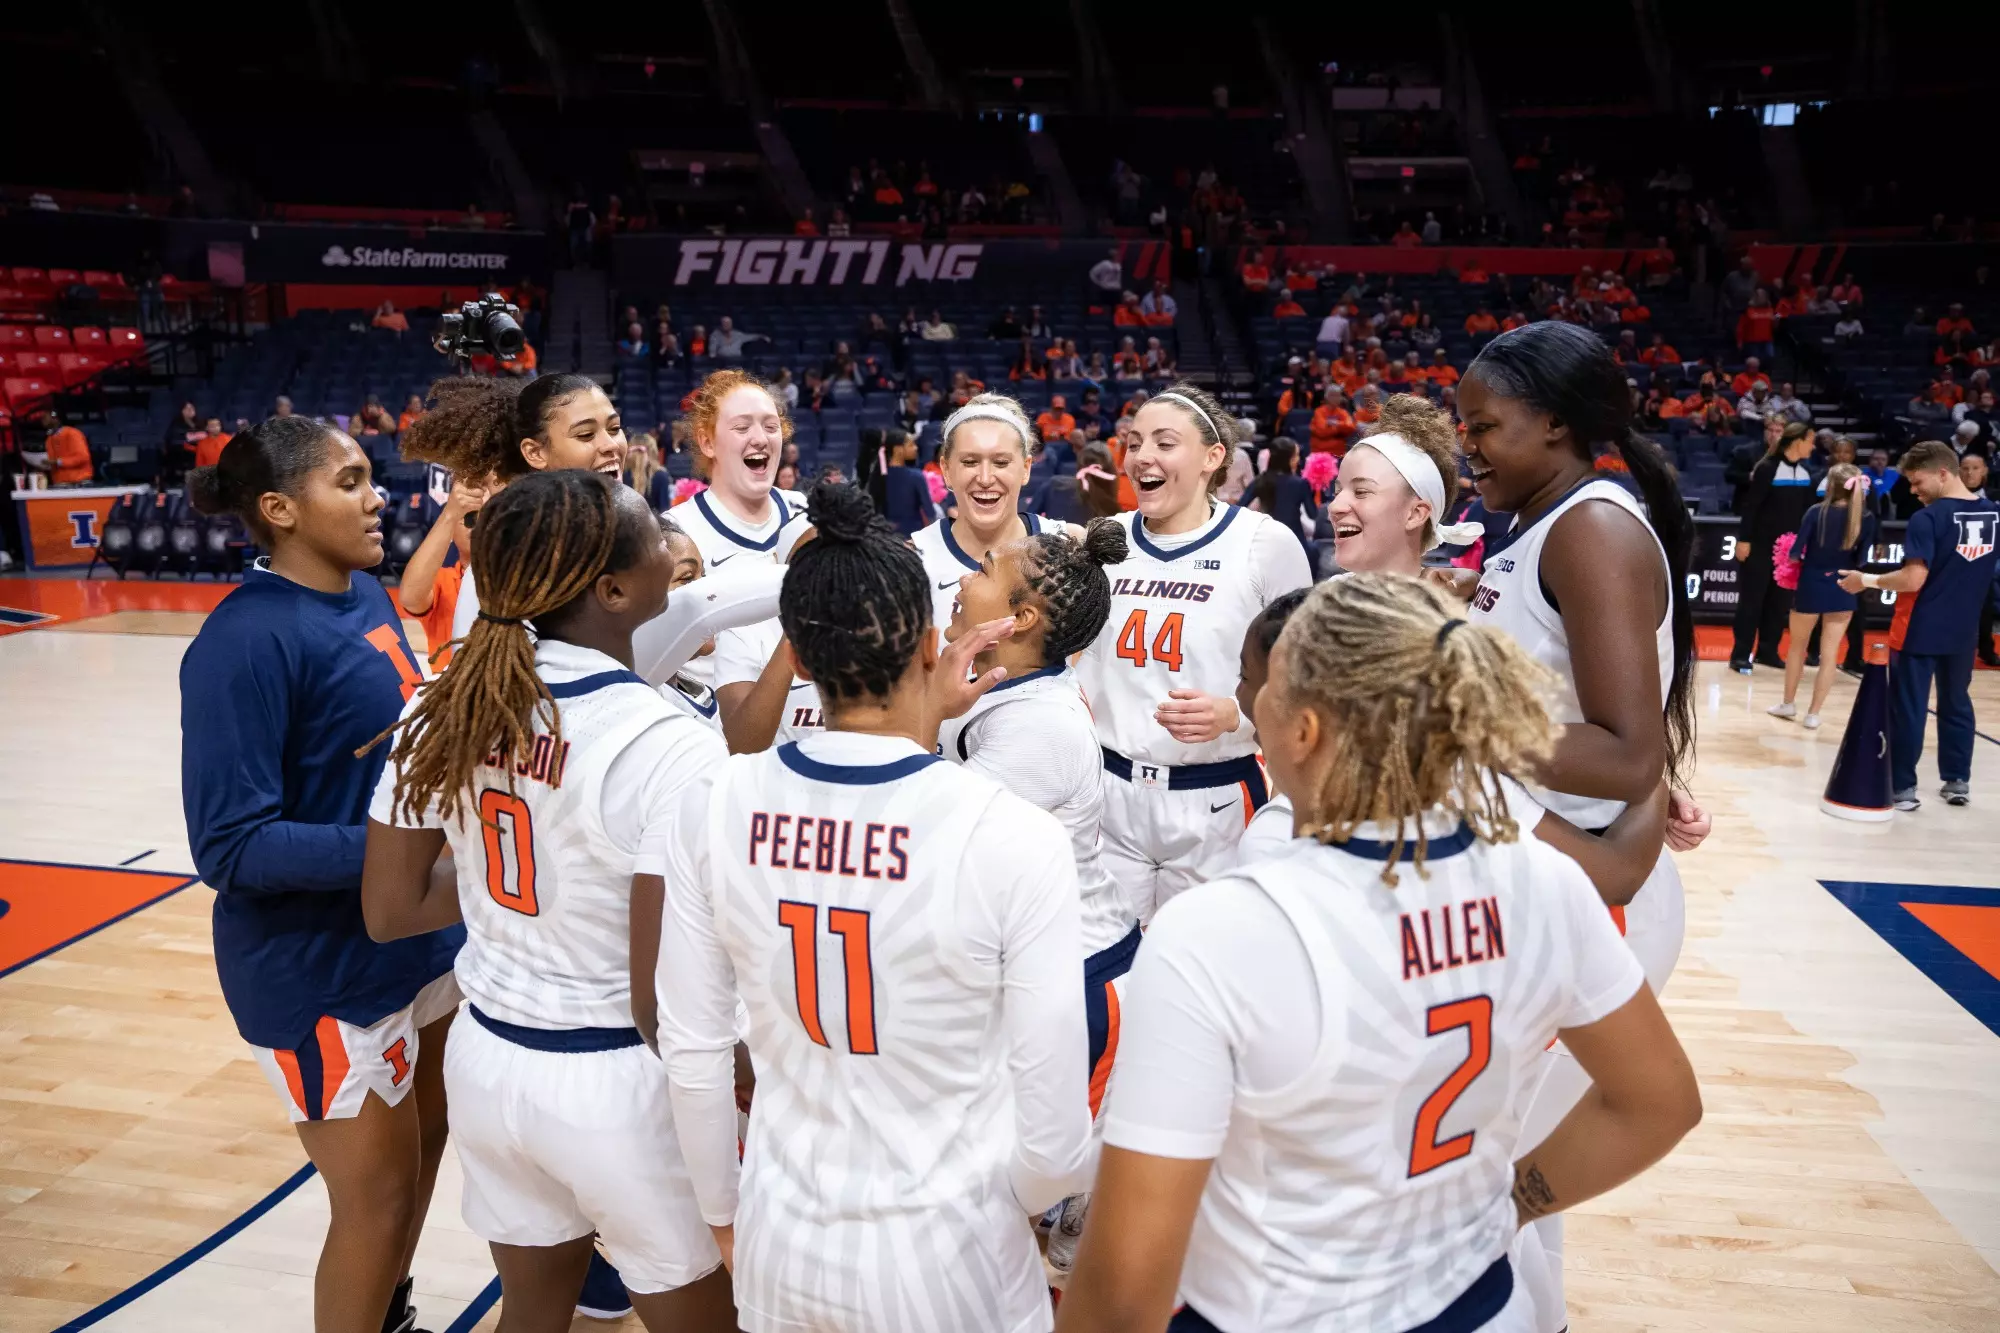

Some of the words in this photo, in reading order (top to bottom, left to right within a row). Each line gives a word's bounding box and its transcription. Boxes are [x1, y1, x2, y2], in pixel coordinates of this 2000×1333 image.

[448, 253, 508, 269] CENTER
[1111, 578, 1215, 603] ILLINOIS
[1703, 569, 1737, 583] FOULS
[1116, 608, 1185, 673] 44
[479, 787, 540, 917] 0
[749, 811, 910, 882] PEEBLES
[1399, 895, 1508, 982] ALLEN
[778, 898, 879, 1055] 11
[1407, 993, 1494, 1179] 2
